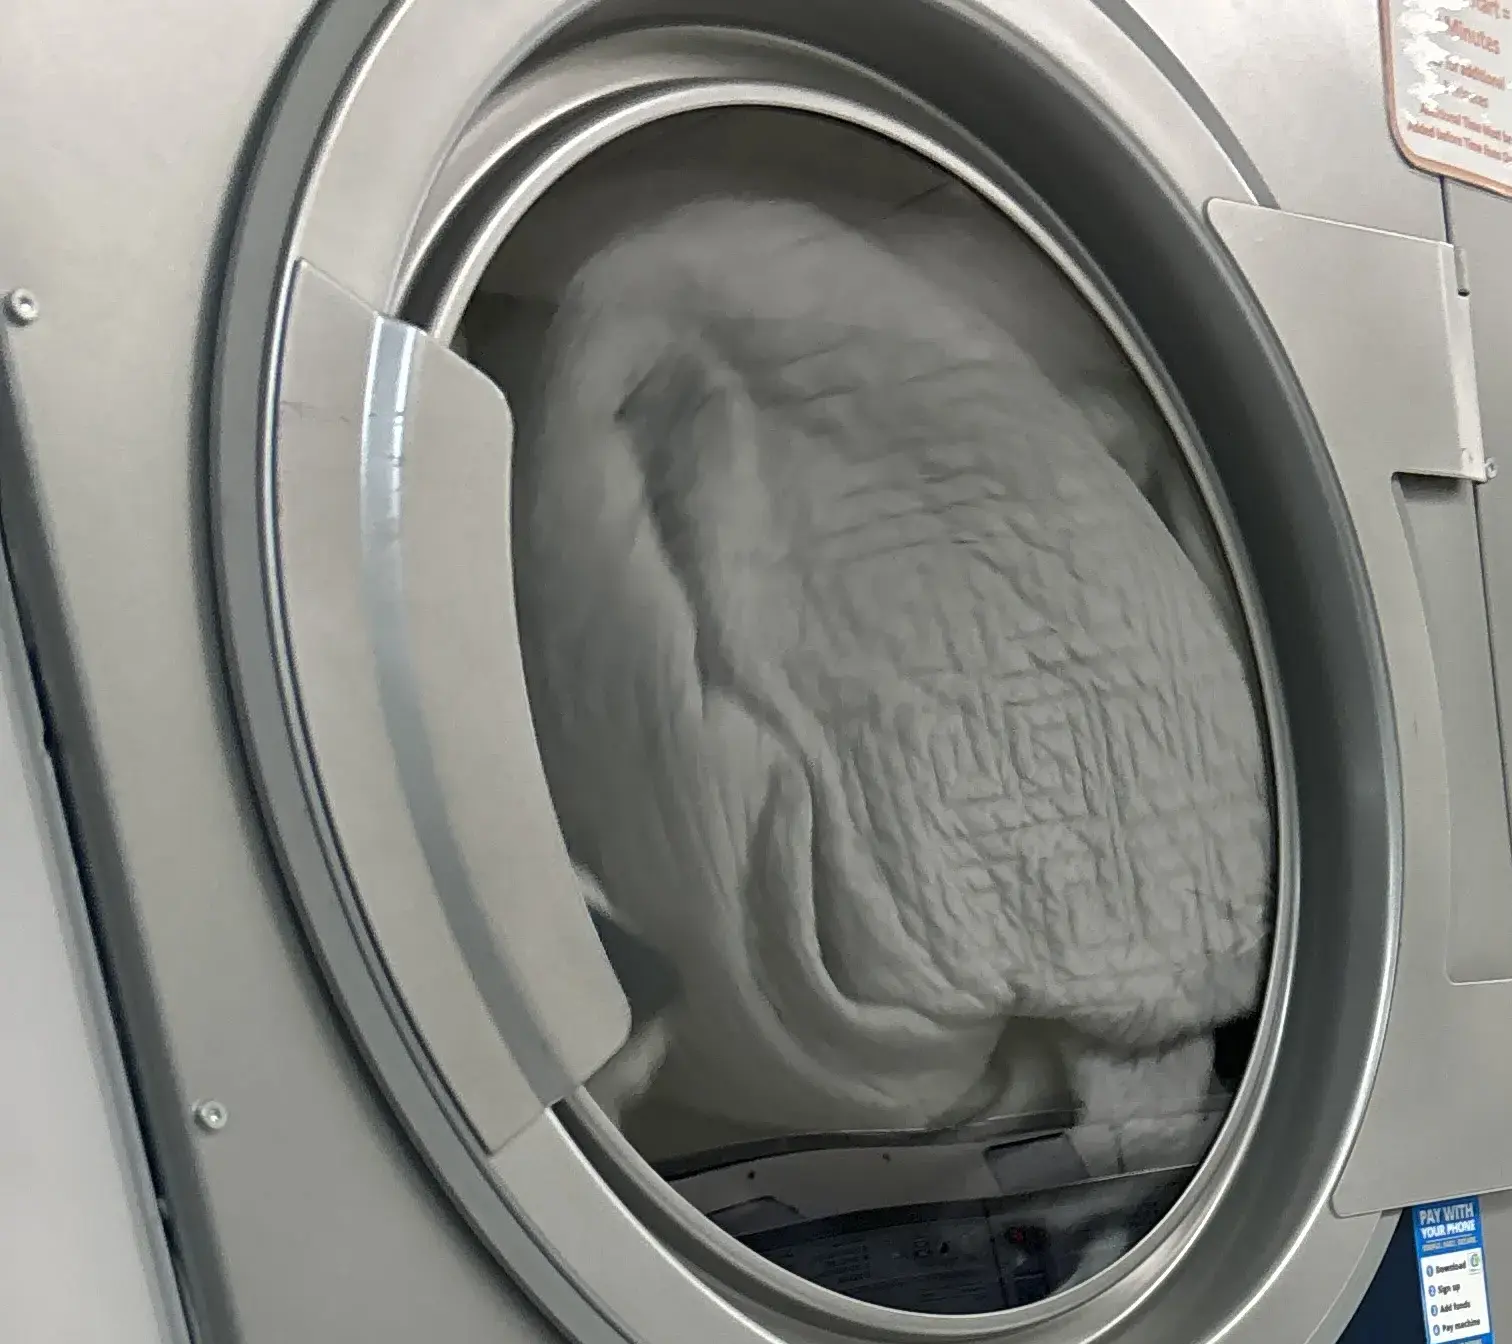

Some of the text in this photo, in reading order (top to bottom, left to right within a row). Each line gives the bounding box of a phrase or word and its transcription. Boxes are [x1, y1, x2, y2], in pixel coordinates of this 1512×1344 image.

[1419, 1203, 1474, 1225] PAY WITH
[1420, 1219, 1476, 1239] YOUR PHONE
[1436, 1260, 1466, 1274] Download
[1438, 1284, 1451, 1294] Sign
[1453, 1300, 1471, 1310] funds
[1442, 1324, 1453, 1333] Pay
[1455, 1318, 1480, 1329] machine
